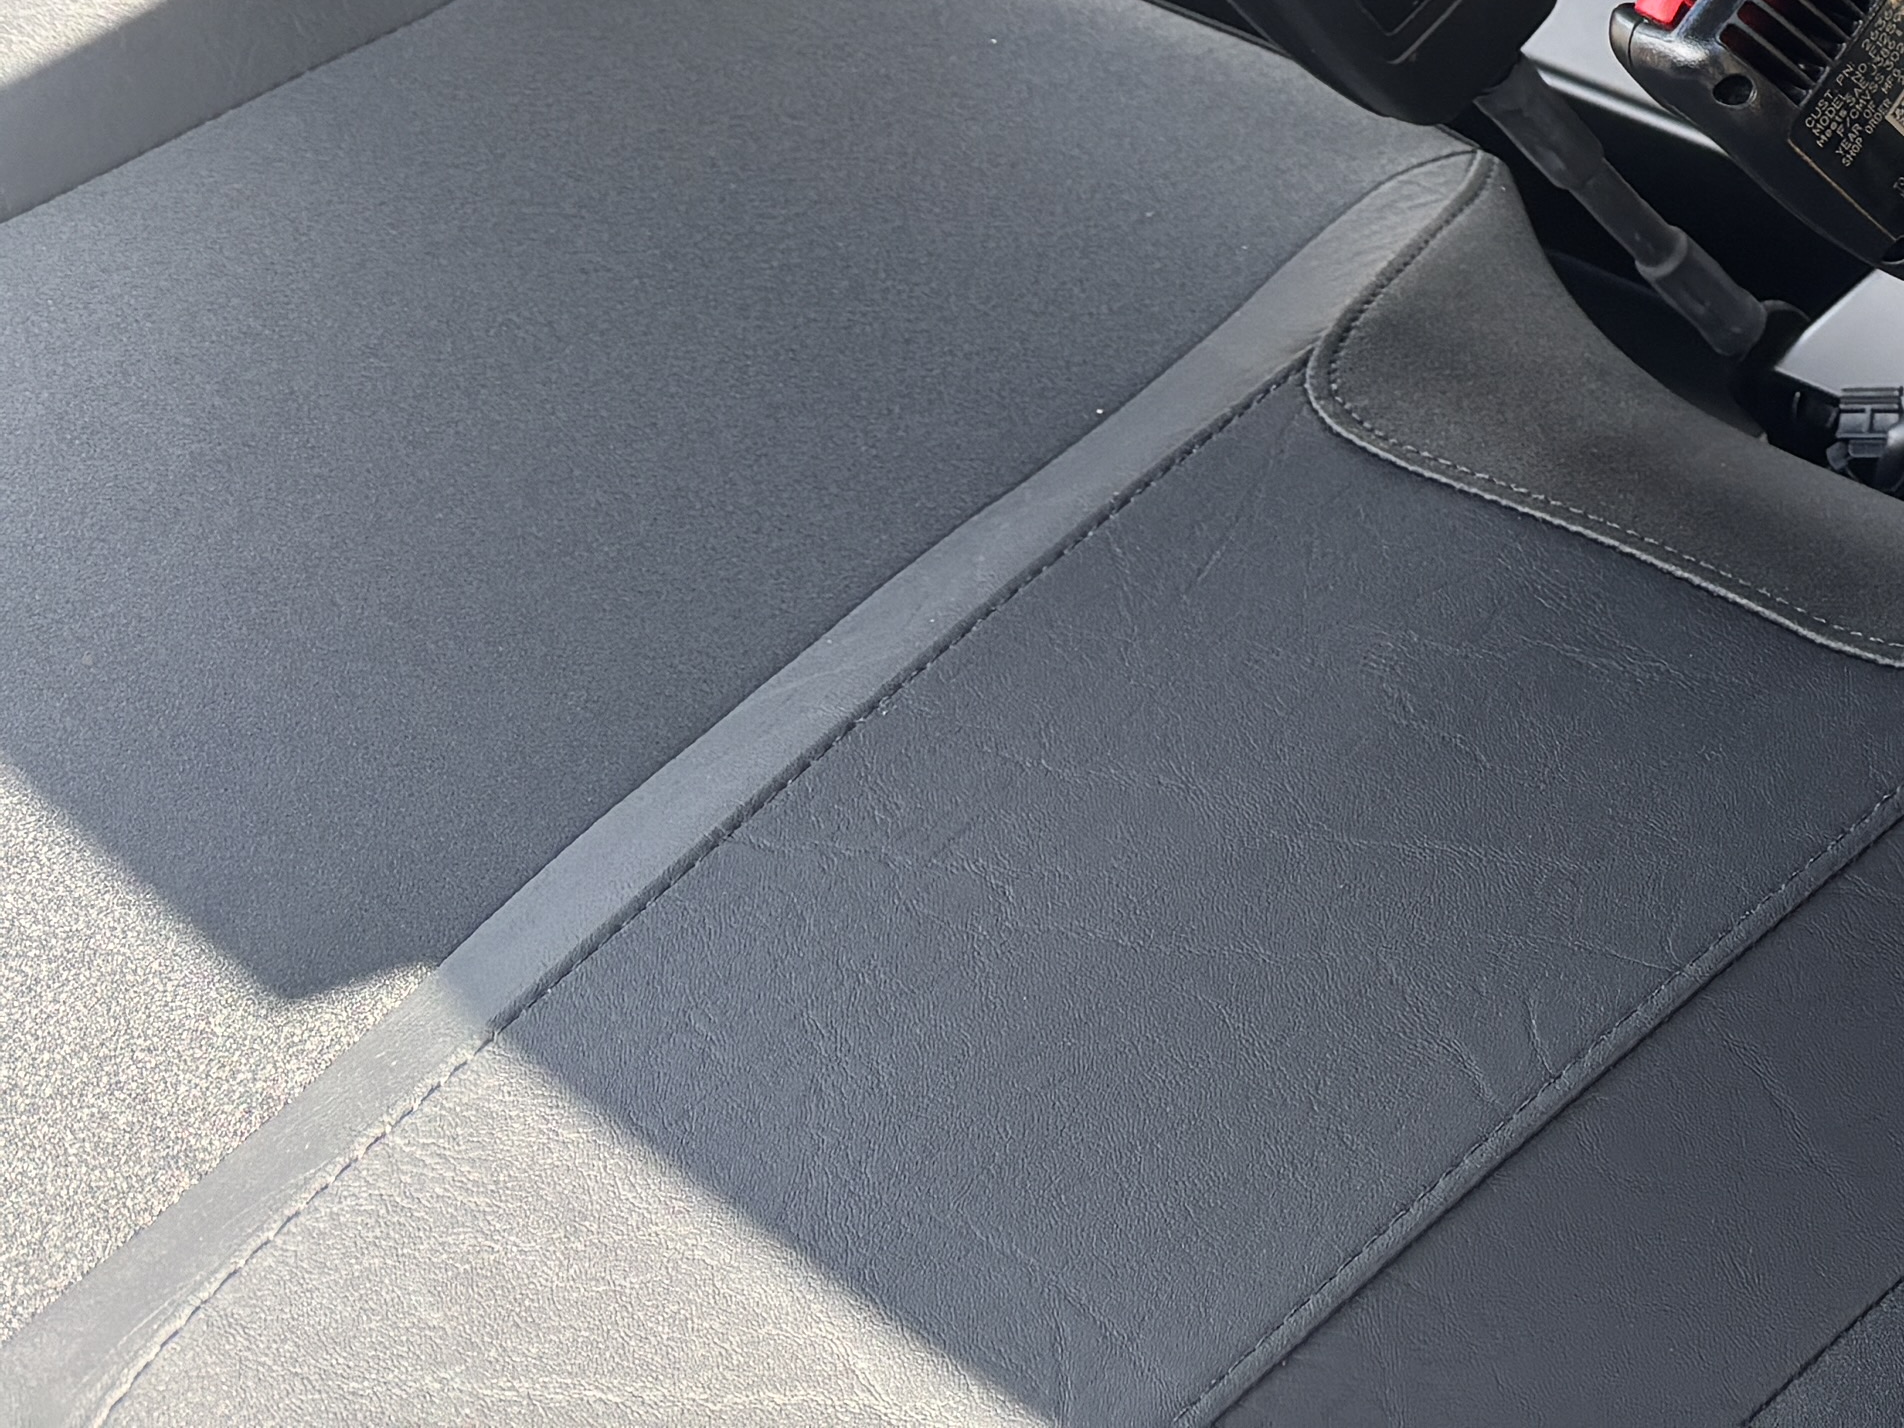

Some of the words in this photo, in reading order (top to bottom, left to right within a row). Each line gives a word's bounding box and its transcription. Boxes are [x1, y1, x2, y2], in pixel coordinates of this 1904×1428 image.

[1812, 93, 1847, 136] MODEL
[1845, 76, 1869, 106] SAE
[1835, 122, 1862, 156] YEAR
[1862, 100, 1876, 118] OF
[1841, 137, 1863, 166] SHOP
[1864, 98, 1892, 134] ORDER
